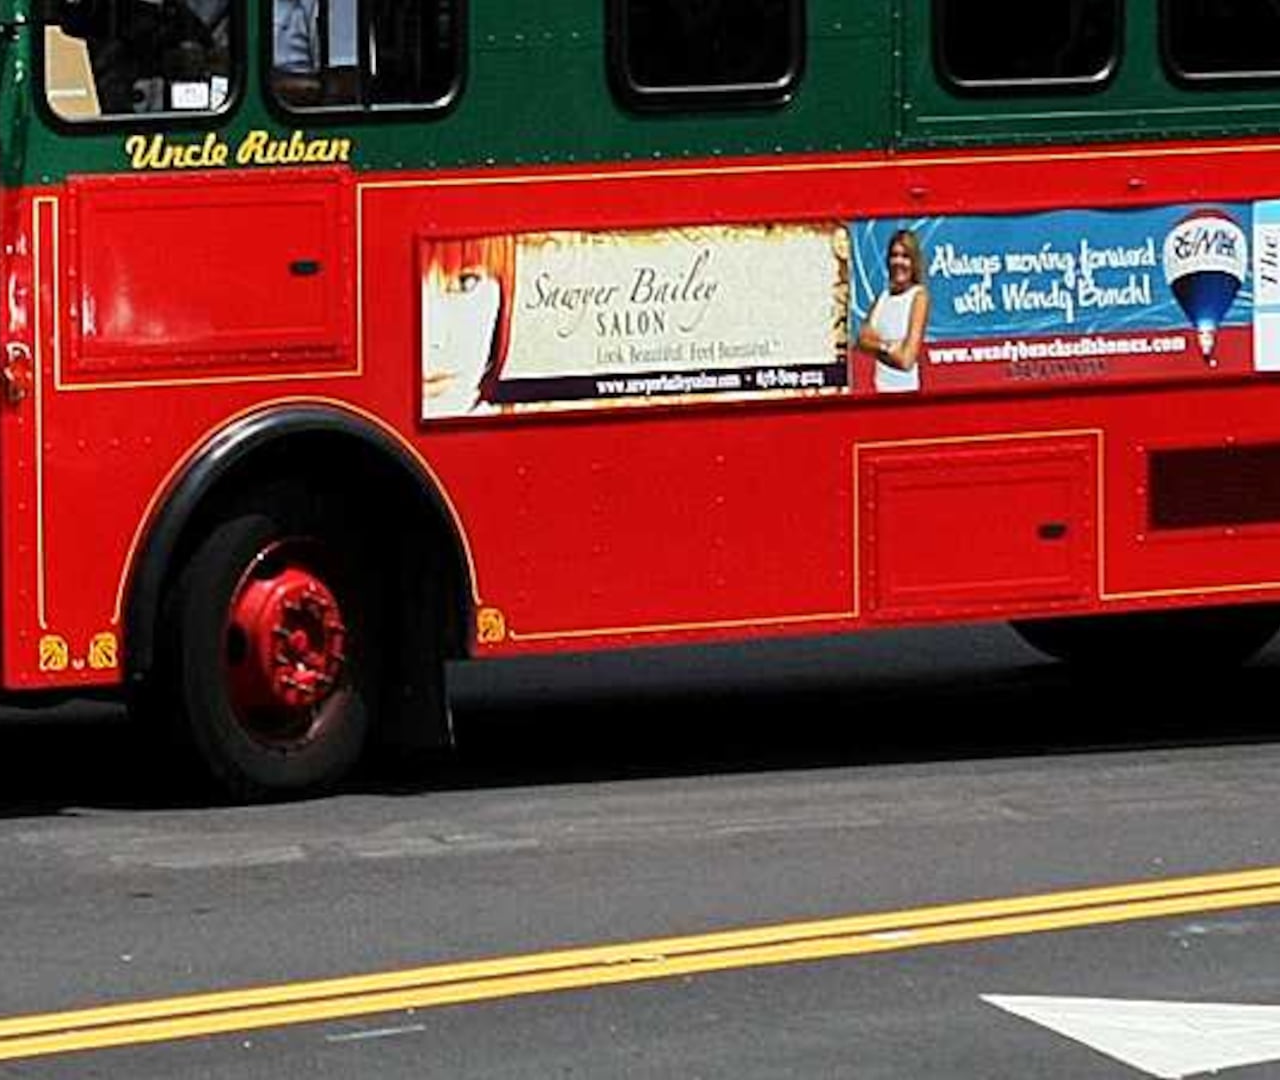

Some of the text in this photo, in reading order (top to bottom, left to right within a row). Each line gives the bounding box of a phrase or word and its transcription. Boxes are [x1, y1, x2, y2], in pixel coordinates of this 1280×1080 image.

[125, 129, 352, 170] Uncle Ruban
[928, 237, 1157, 288] Always moving forward
[526, 249, 720, 339] Sawyer Bailey
[953, 284, 994, 315] with
[1002, 282, 1075, 323] Wendy
[595, 309, 667, 338] SALON
